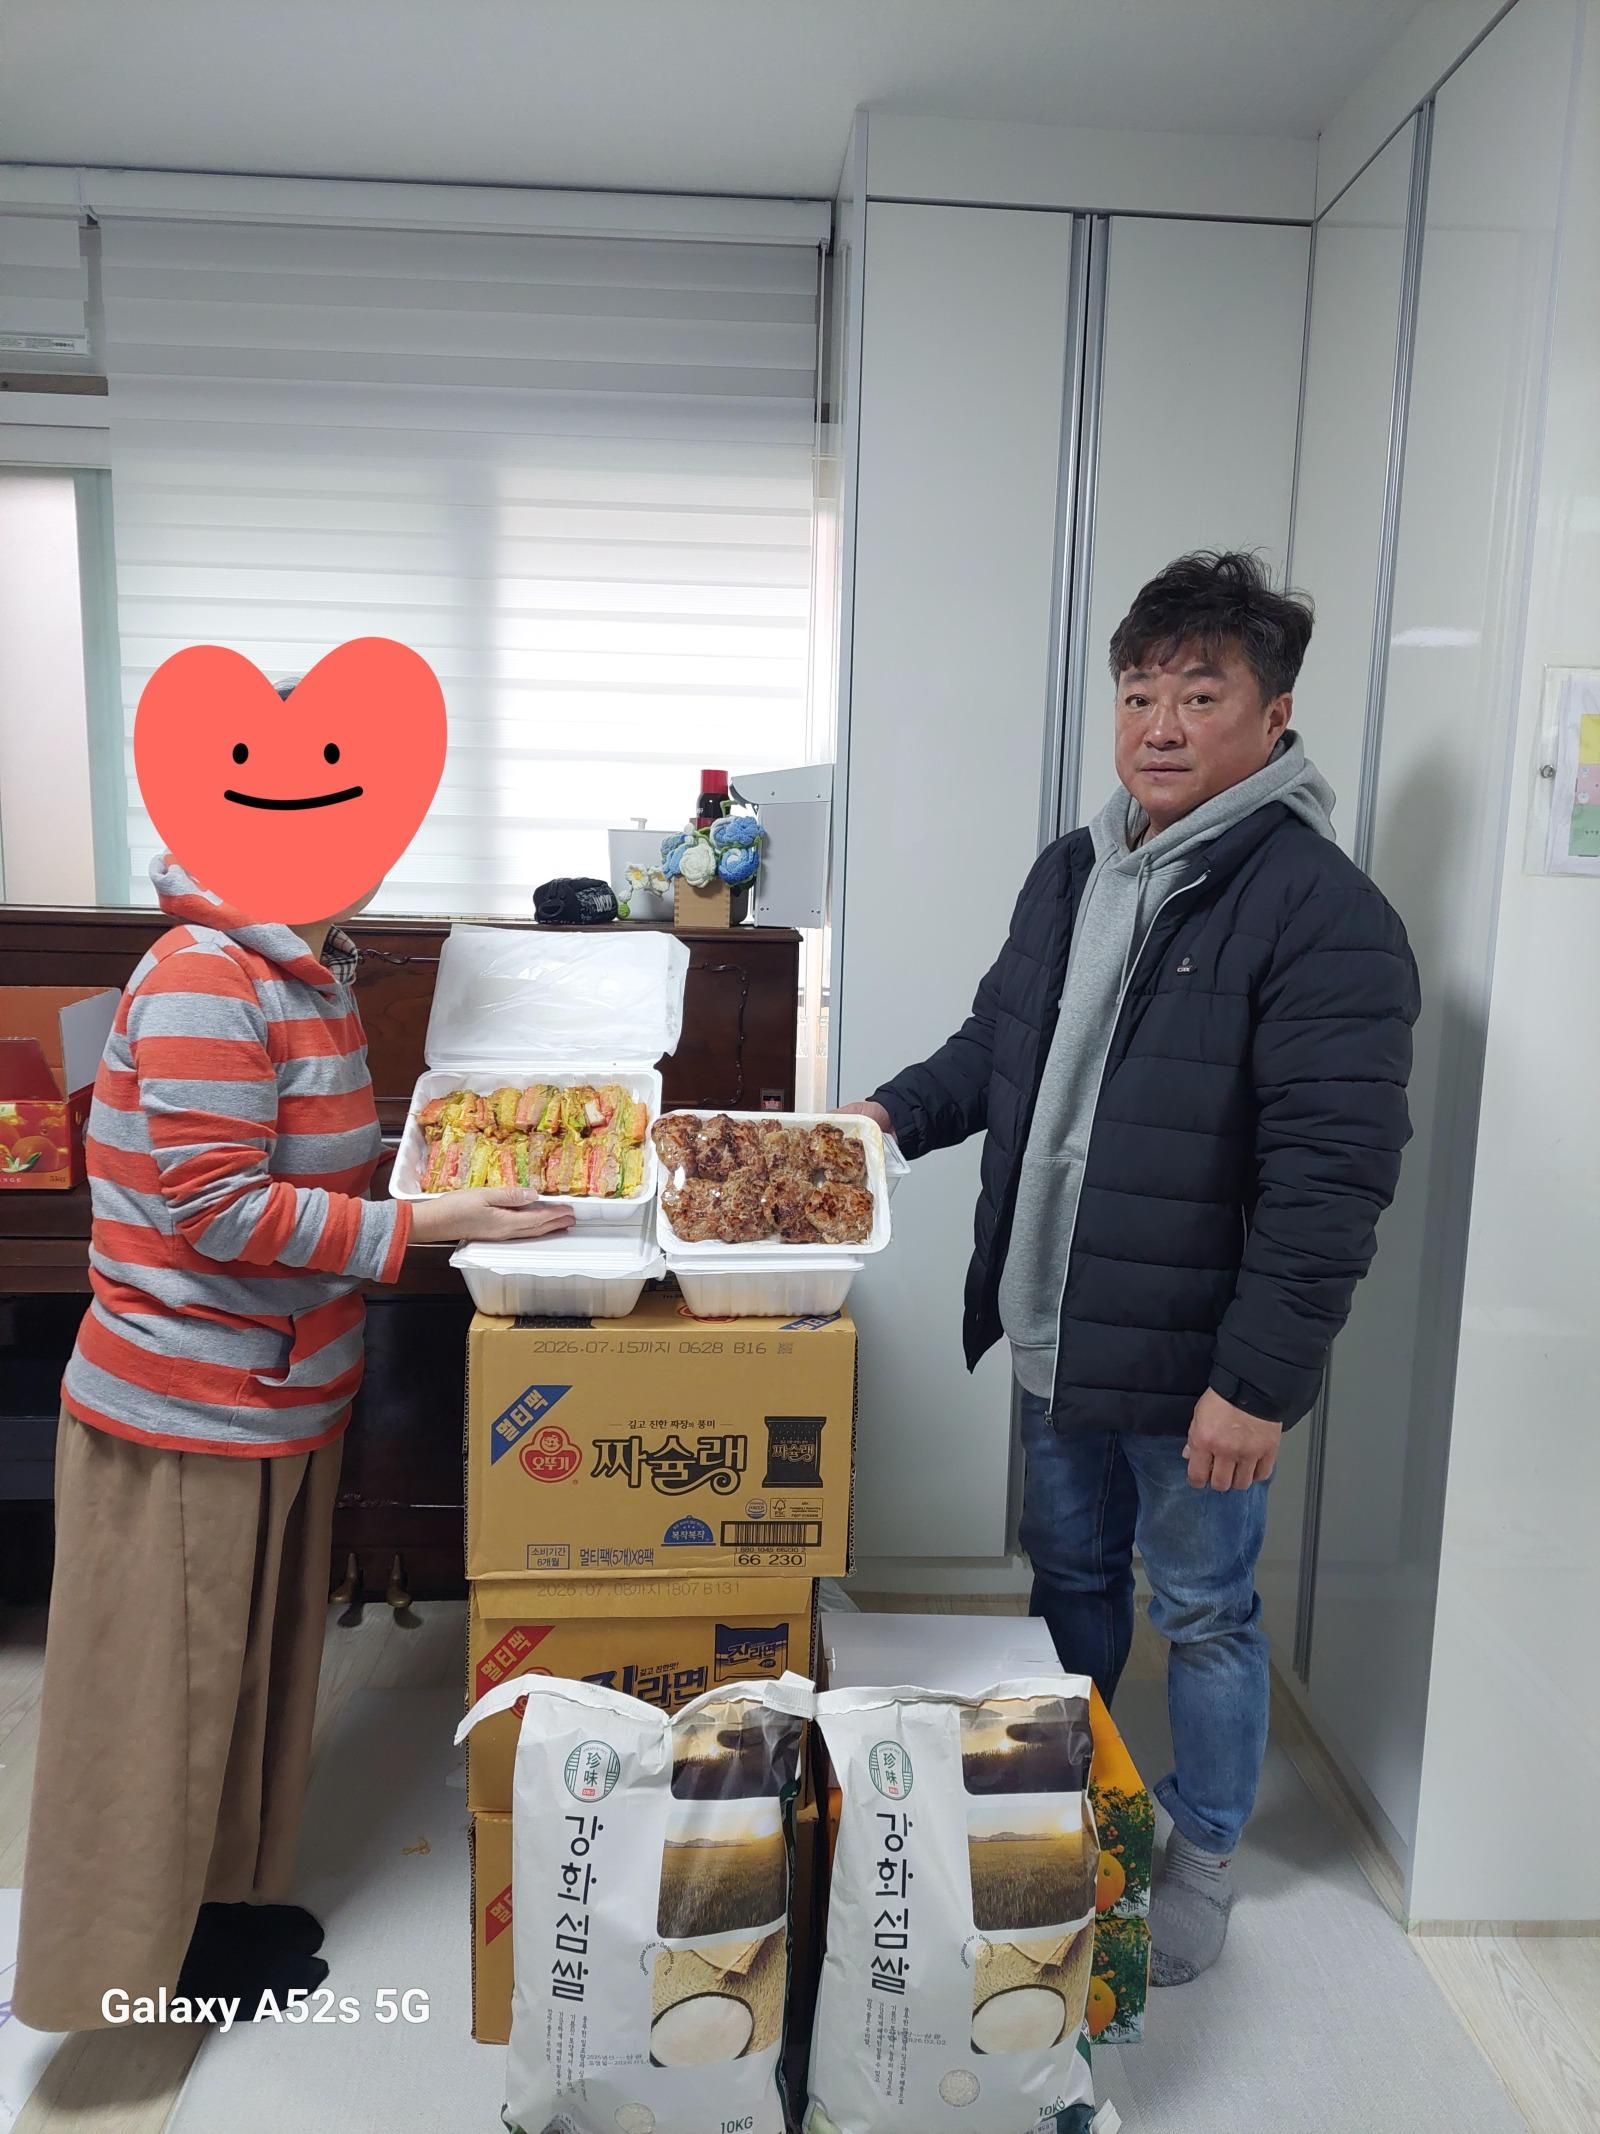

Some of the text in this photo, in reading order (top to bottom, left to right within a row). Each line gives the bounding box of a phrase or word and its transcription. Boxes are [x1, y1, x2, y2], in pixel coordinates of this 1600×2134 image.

[533, 1340, 767, 1354] 2026.07.15까지 0628 B16
[495, 1389, 549, 1442] 멀티팩
[649, 1419, 667, 1430] 진한
[697, 1419, 716, 1430] 풍미
[771, 1444, 816, 1463] 짜슐랭
[532, 1456, 570, 1471] 오뚜기
[590, 1434, 748, 1497] 짜슐랭
[530, 1547, 566, 1557] 소비기간
[738, 1554, 803, 1566] 66 230
[536, 1558, 560, 1567] 6개월
[480, 1630, 532, 1682] 멀티팩
[583, 1751, 602, 1788] 珍味
[882, 1752, 898, 1787] 珍味
[551, 1815, 604, 2003] 강화섬쌀
[870, 1812, 914, 1996] 강화섬쌀
[720, 2115, 754, 2134] 10KG
